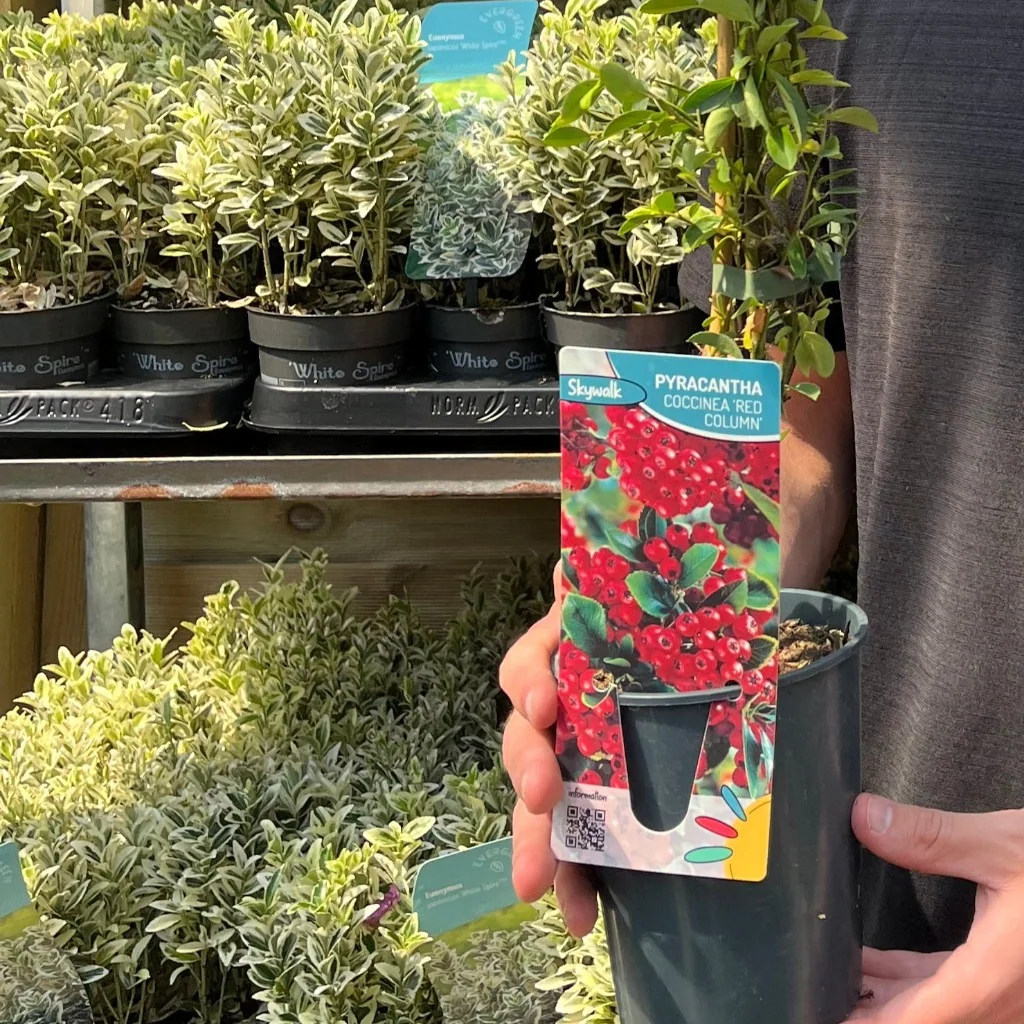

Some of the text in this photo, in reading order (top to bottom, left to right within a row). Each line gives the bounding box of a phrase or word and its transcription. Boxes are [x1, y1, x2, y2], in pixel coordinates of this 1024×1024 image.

[567, 378, 623, 401] Skywalk
[655, 374, 763, 396] PYRACANTHA
[100, 397, 145, 424] 418
[663, 393, 730, 411] COCCINEA
[567, 787, 608, 802] information
